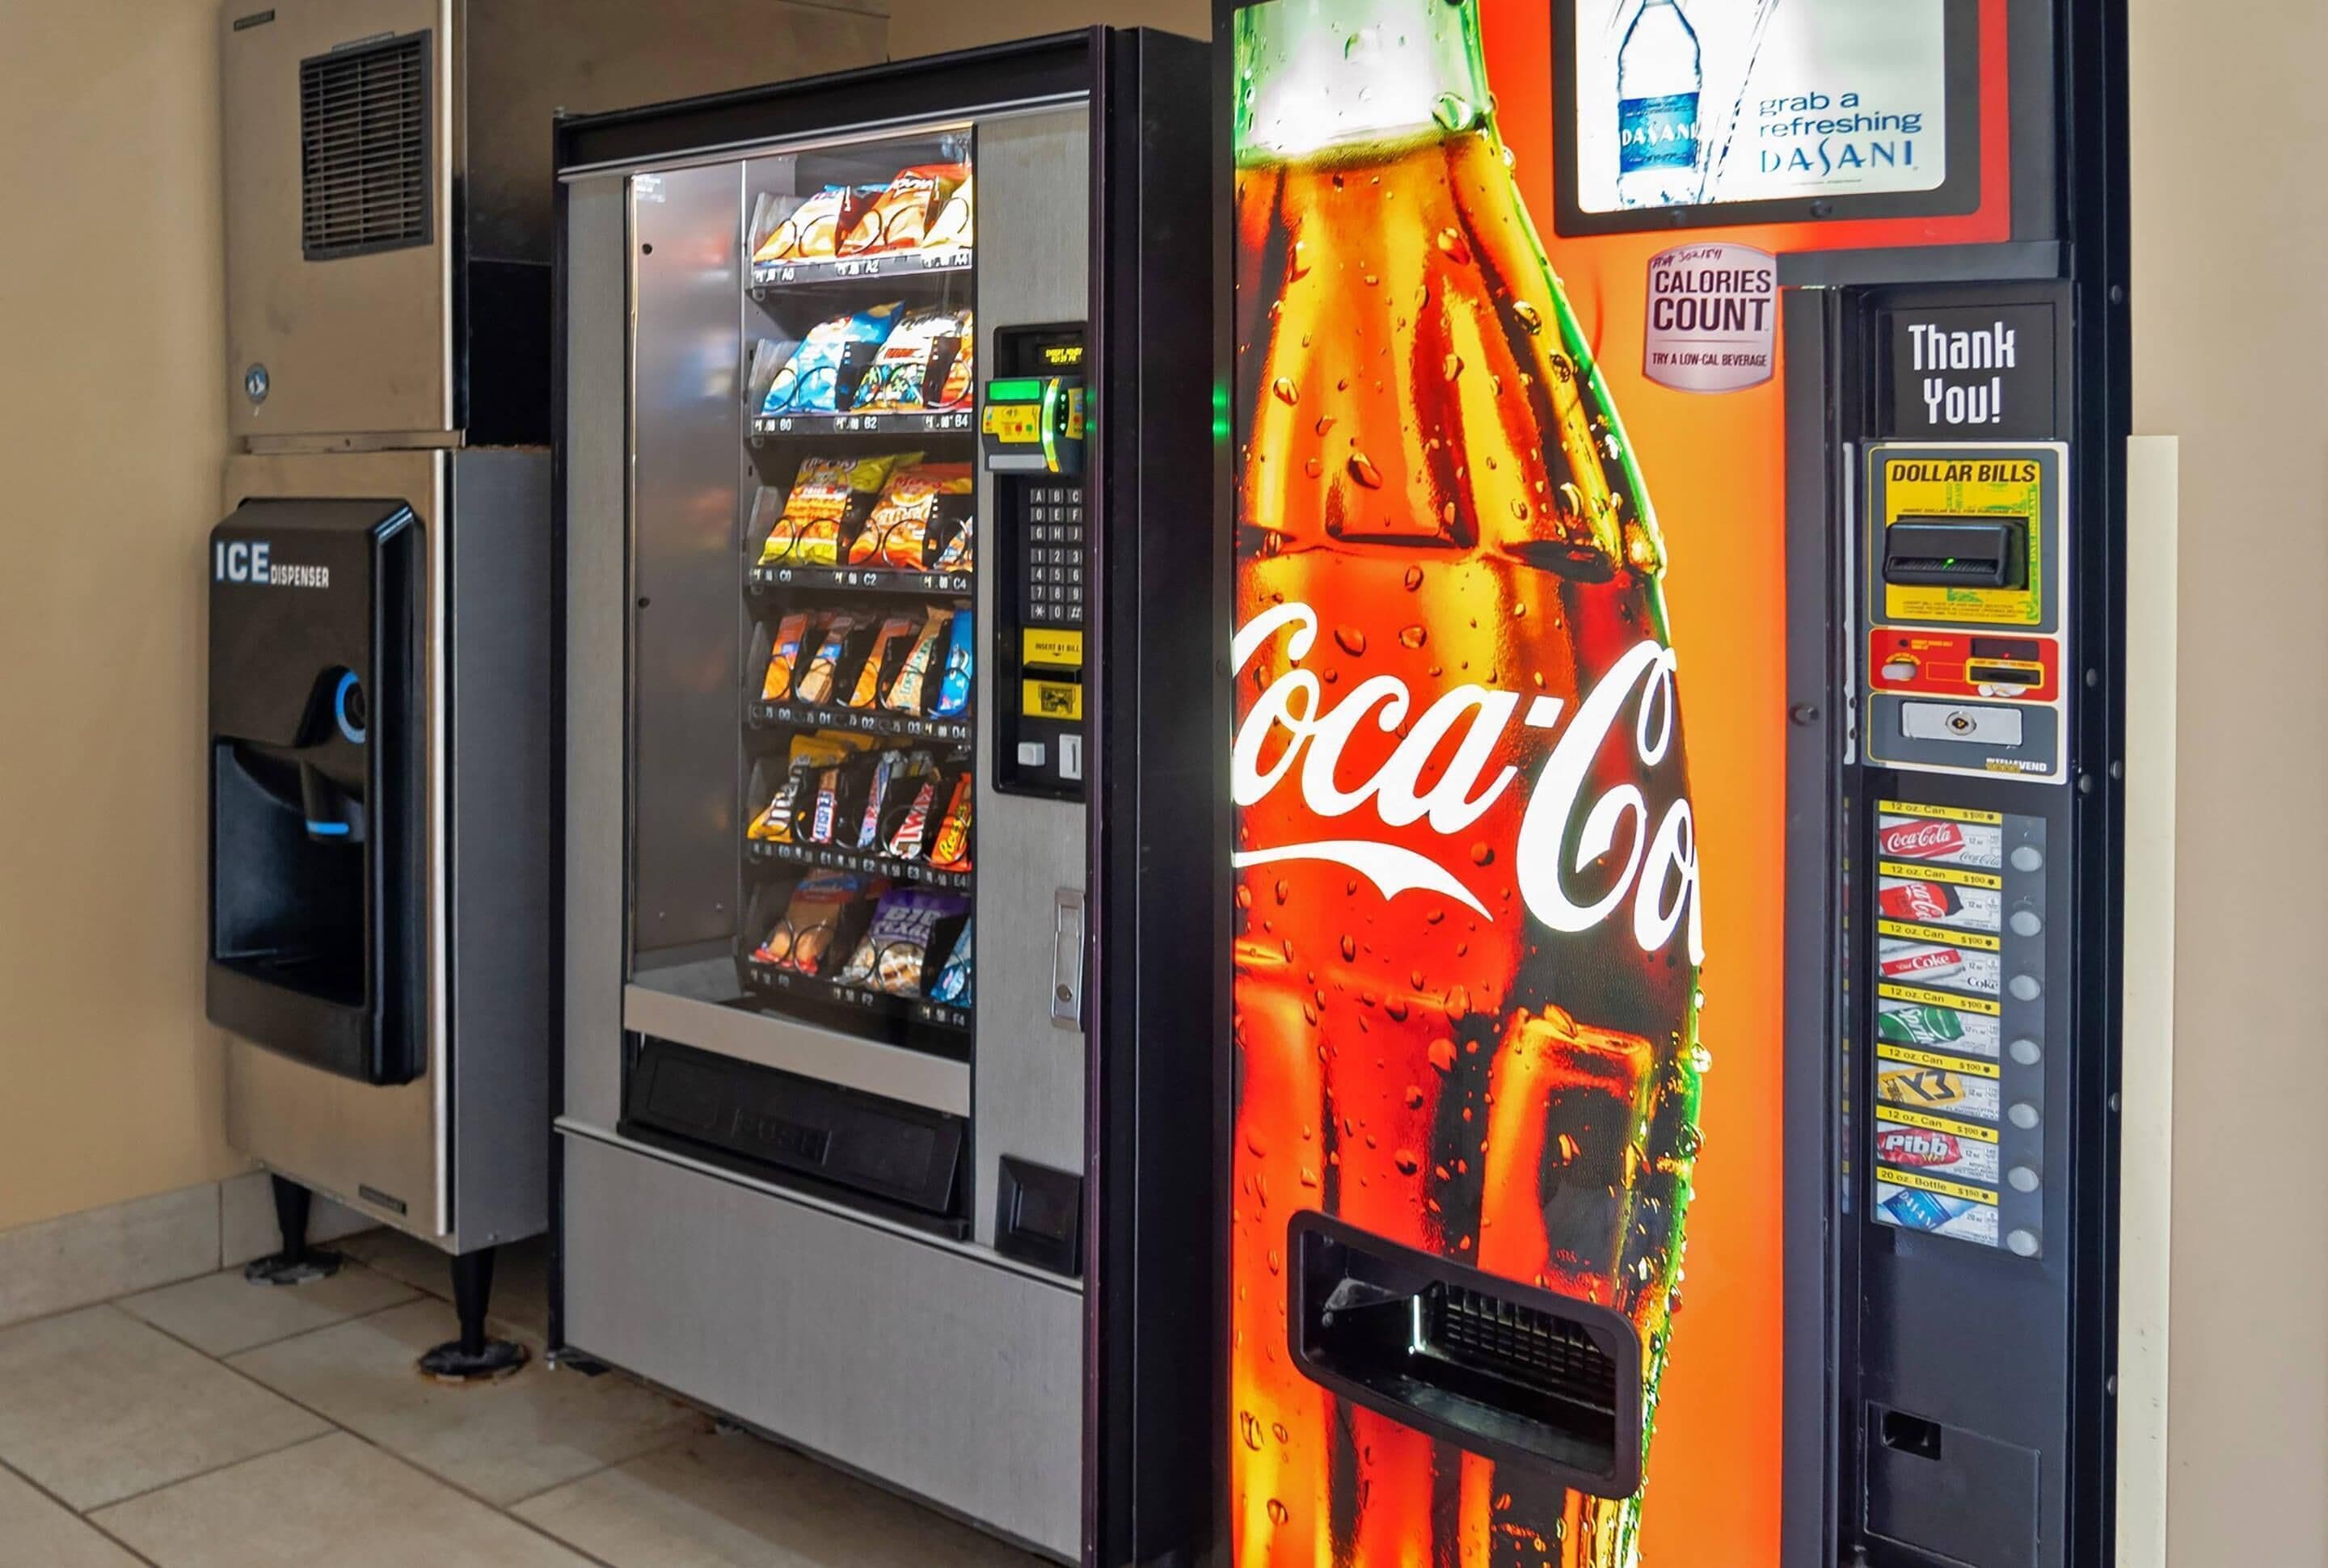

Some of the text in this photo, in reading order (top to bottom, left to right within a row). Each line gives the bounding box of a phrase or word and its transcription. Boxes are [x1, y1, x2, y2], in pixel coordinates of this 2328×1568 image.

[1760, 92, 1859, 116] grab a
[1760, 112, 1923, 137] refreshing
[1622, 121, 1698, 147] DASANI
[1761, 137, 1913, 177] DASANI
[1654, 269, 1772, 294] CALORIES
[1652, 297, 1771, 331] COUNT
[1908, 321, 2016, 371] Thank
[1652, 352, 1767, 367] TRY A LOW-CAL BEVERAGE
[1923, 376, 2001, 424] You!
[1891, 464, 2036, 483] DOLLAR BILLS
[1035, 490, 1079, 503] A B C
[1054, 508, 1061, 521] E
[1072, 508, 1079, 521] F
[1054, 527, 1061, 539] H
[1072, 527, 1079, 539] J
[215, 541, 330, 588] ICE DISPENSER
[1035, 550, 1079, 563] 1 2 3
[953, 576, 967, 590] C4
[1035, 568, 1079, 581] 4 5 6
[1035, 587, 1079, 600] 7 8 9
[1891, 802, 1901, 810] 12
[1924, 805, 1946, 816] Can
[1887, 822, 1951, 853] Coca-Cola
[1892, 866, 1903, 874] 12
[1924, 869, 1946, 879] Can
[1890, 924, 1902, 933] 12
[1923, 929, 1945, 939] Can
[1912, 954, 1950, 968] Coke
[1967, 976, 1998, 989] Coke
[1891, 988, 1902, 996] 12
[1923, 992, 1945, 1002] Can
[1889, 1048, 1900, 1057] 12
[1921, 1055, 1943, 1066] Can
[1888, 1110, 1900, 1119] 12
[1921, 1117, 1942, 1128] Can
[1885, 1134, 1949, 1157] Pibb
[1881, 1170, 1894, 1179] 20
[1914, 1178, 1946, 1191] Bottle
